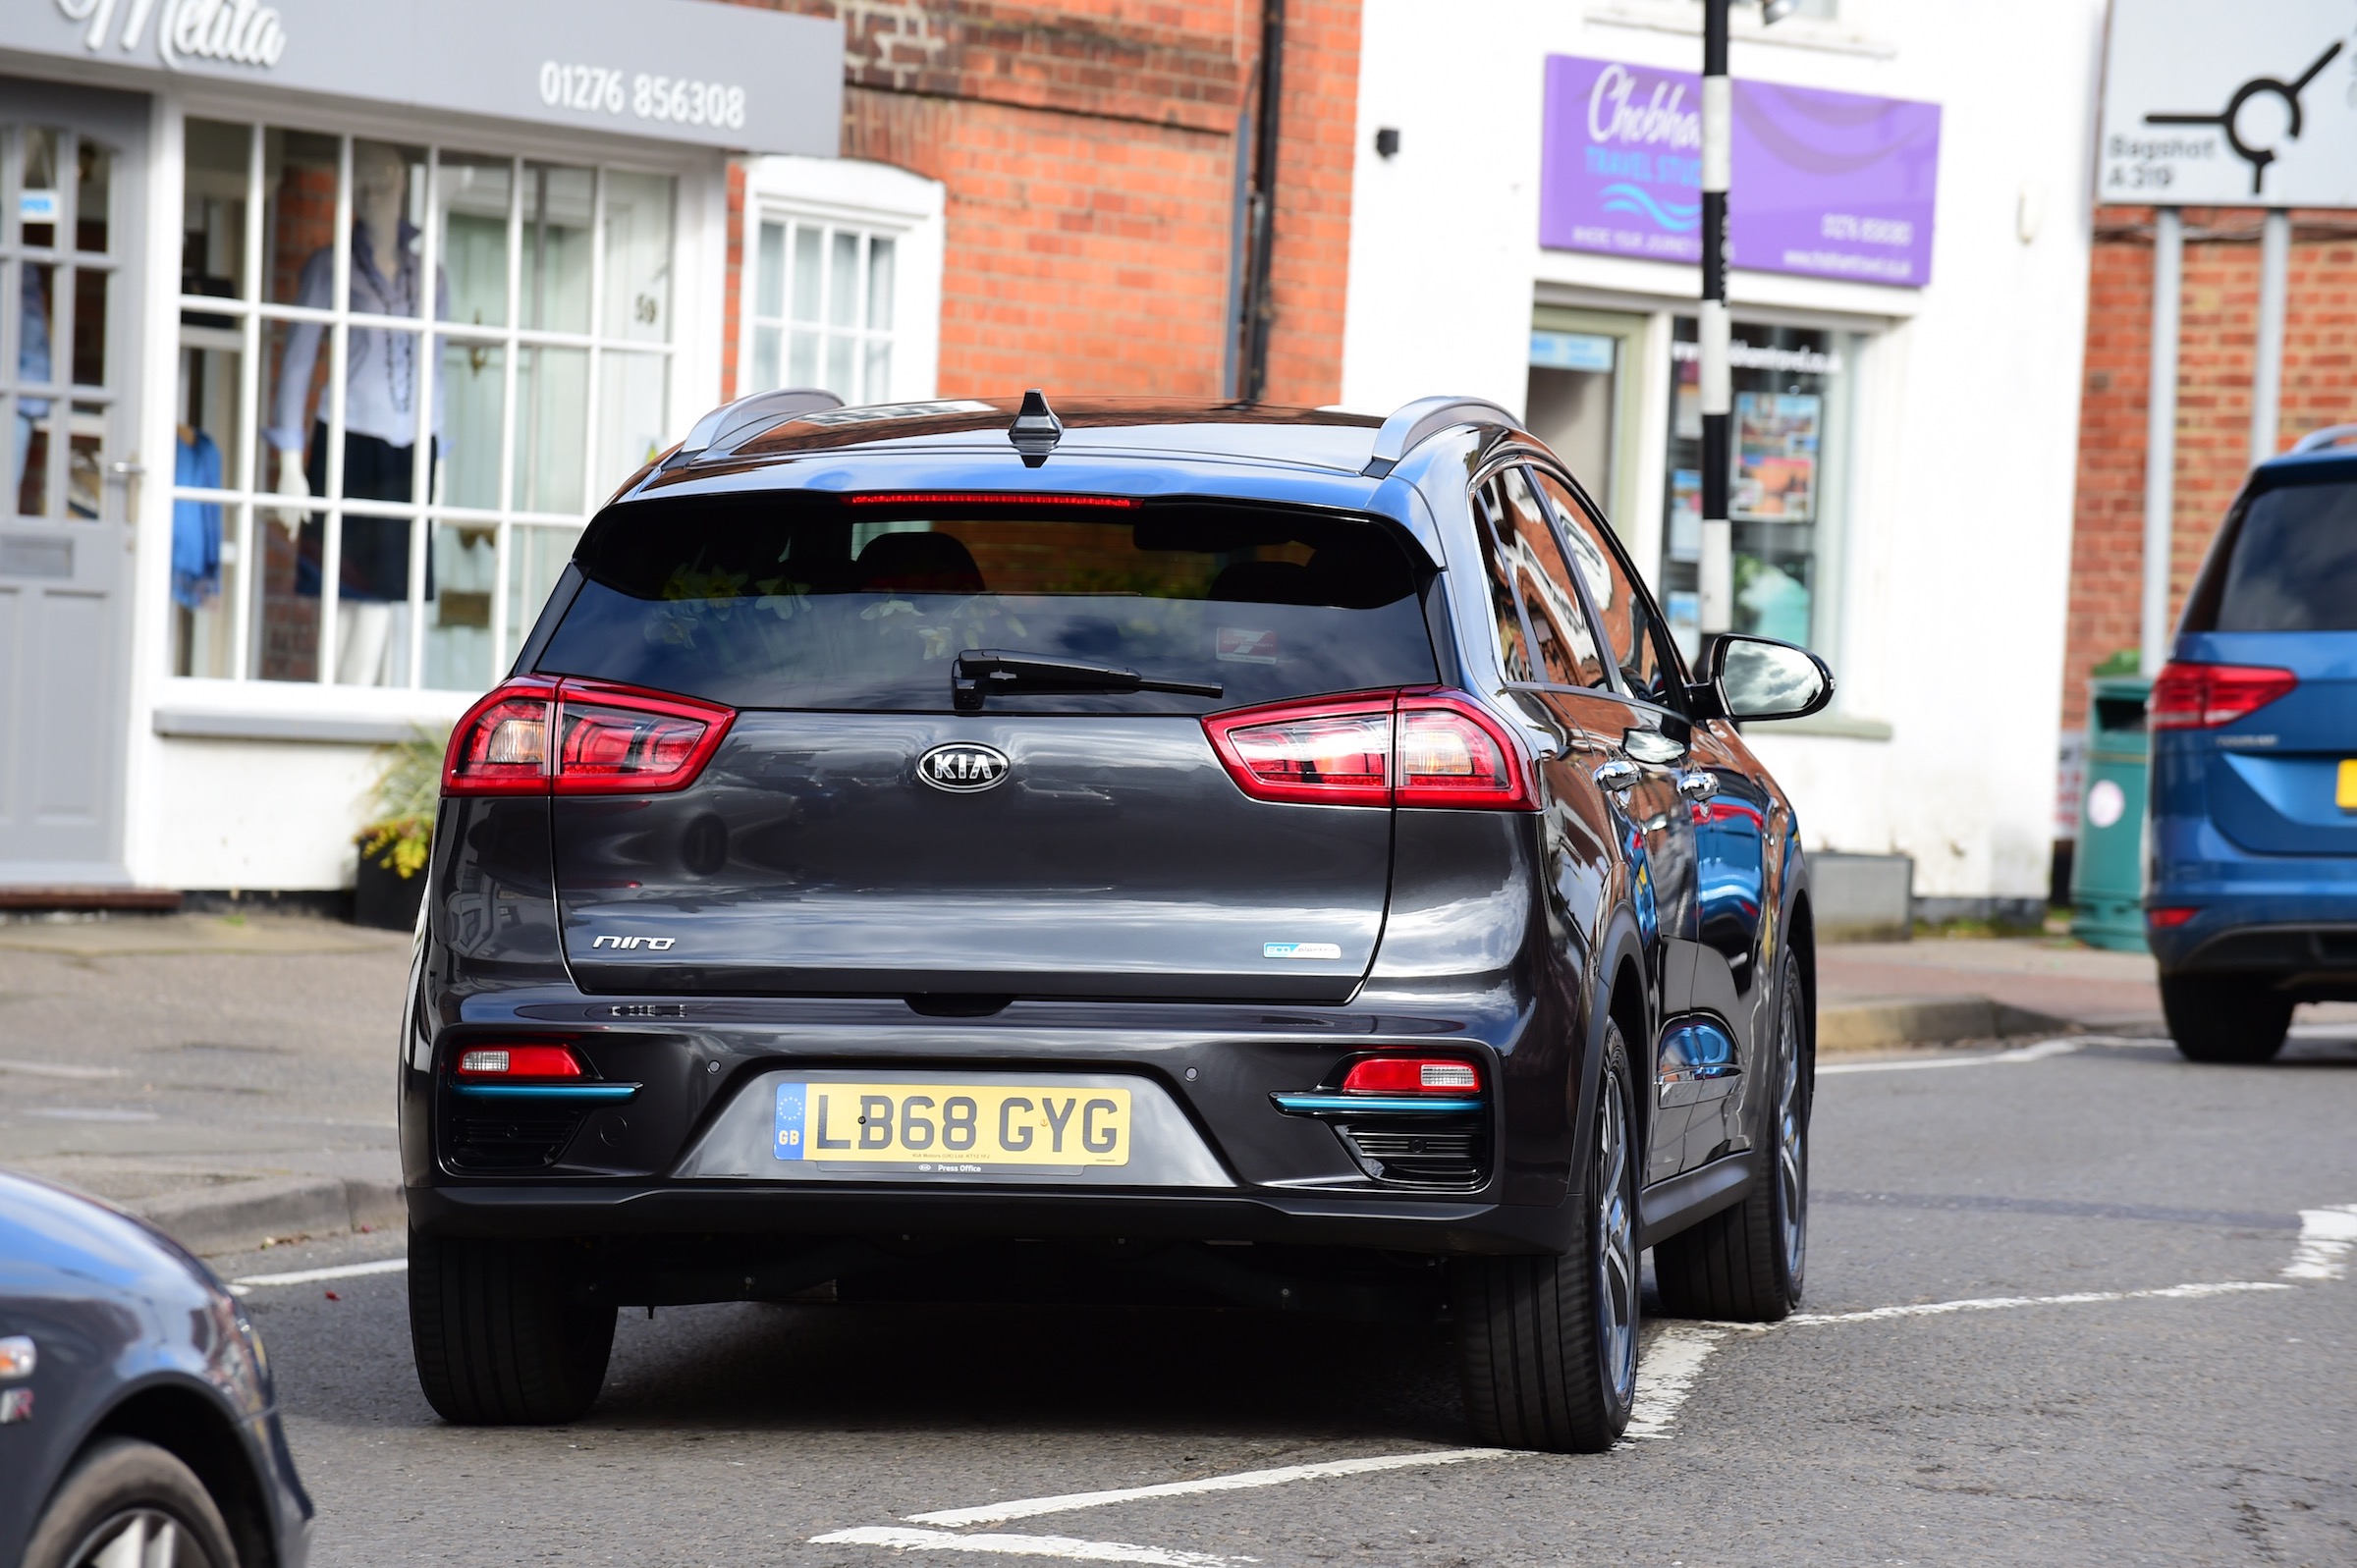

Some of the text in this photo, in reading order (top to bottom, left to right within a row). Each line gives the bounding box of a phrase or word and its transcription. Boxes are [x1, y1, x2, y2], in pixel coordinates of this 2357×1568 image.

[540, 61, 745, 130] 01276 856308
[1588, 64, 1703, 150] Chobha
[2110, 136, 2216, 161] Bagshot
[934, 754, 993, 779] KIA
[816, 1095, 1118, 1154] LB68 GYG
[779, 1130, 799, 1145] GB
[938, 1163, 959, 1172] Press
[959, 1164, 982, 1173] Office
